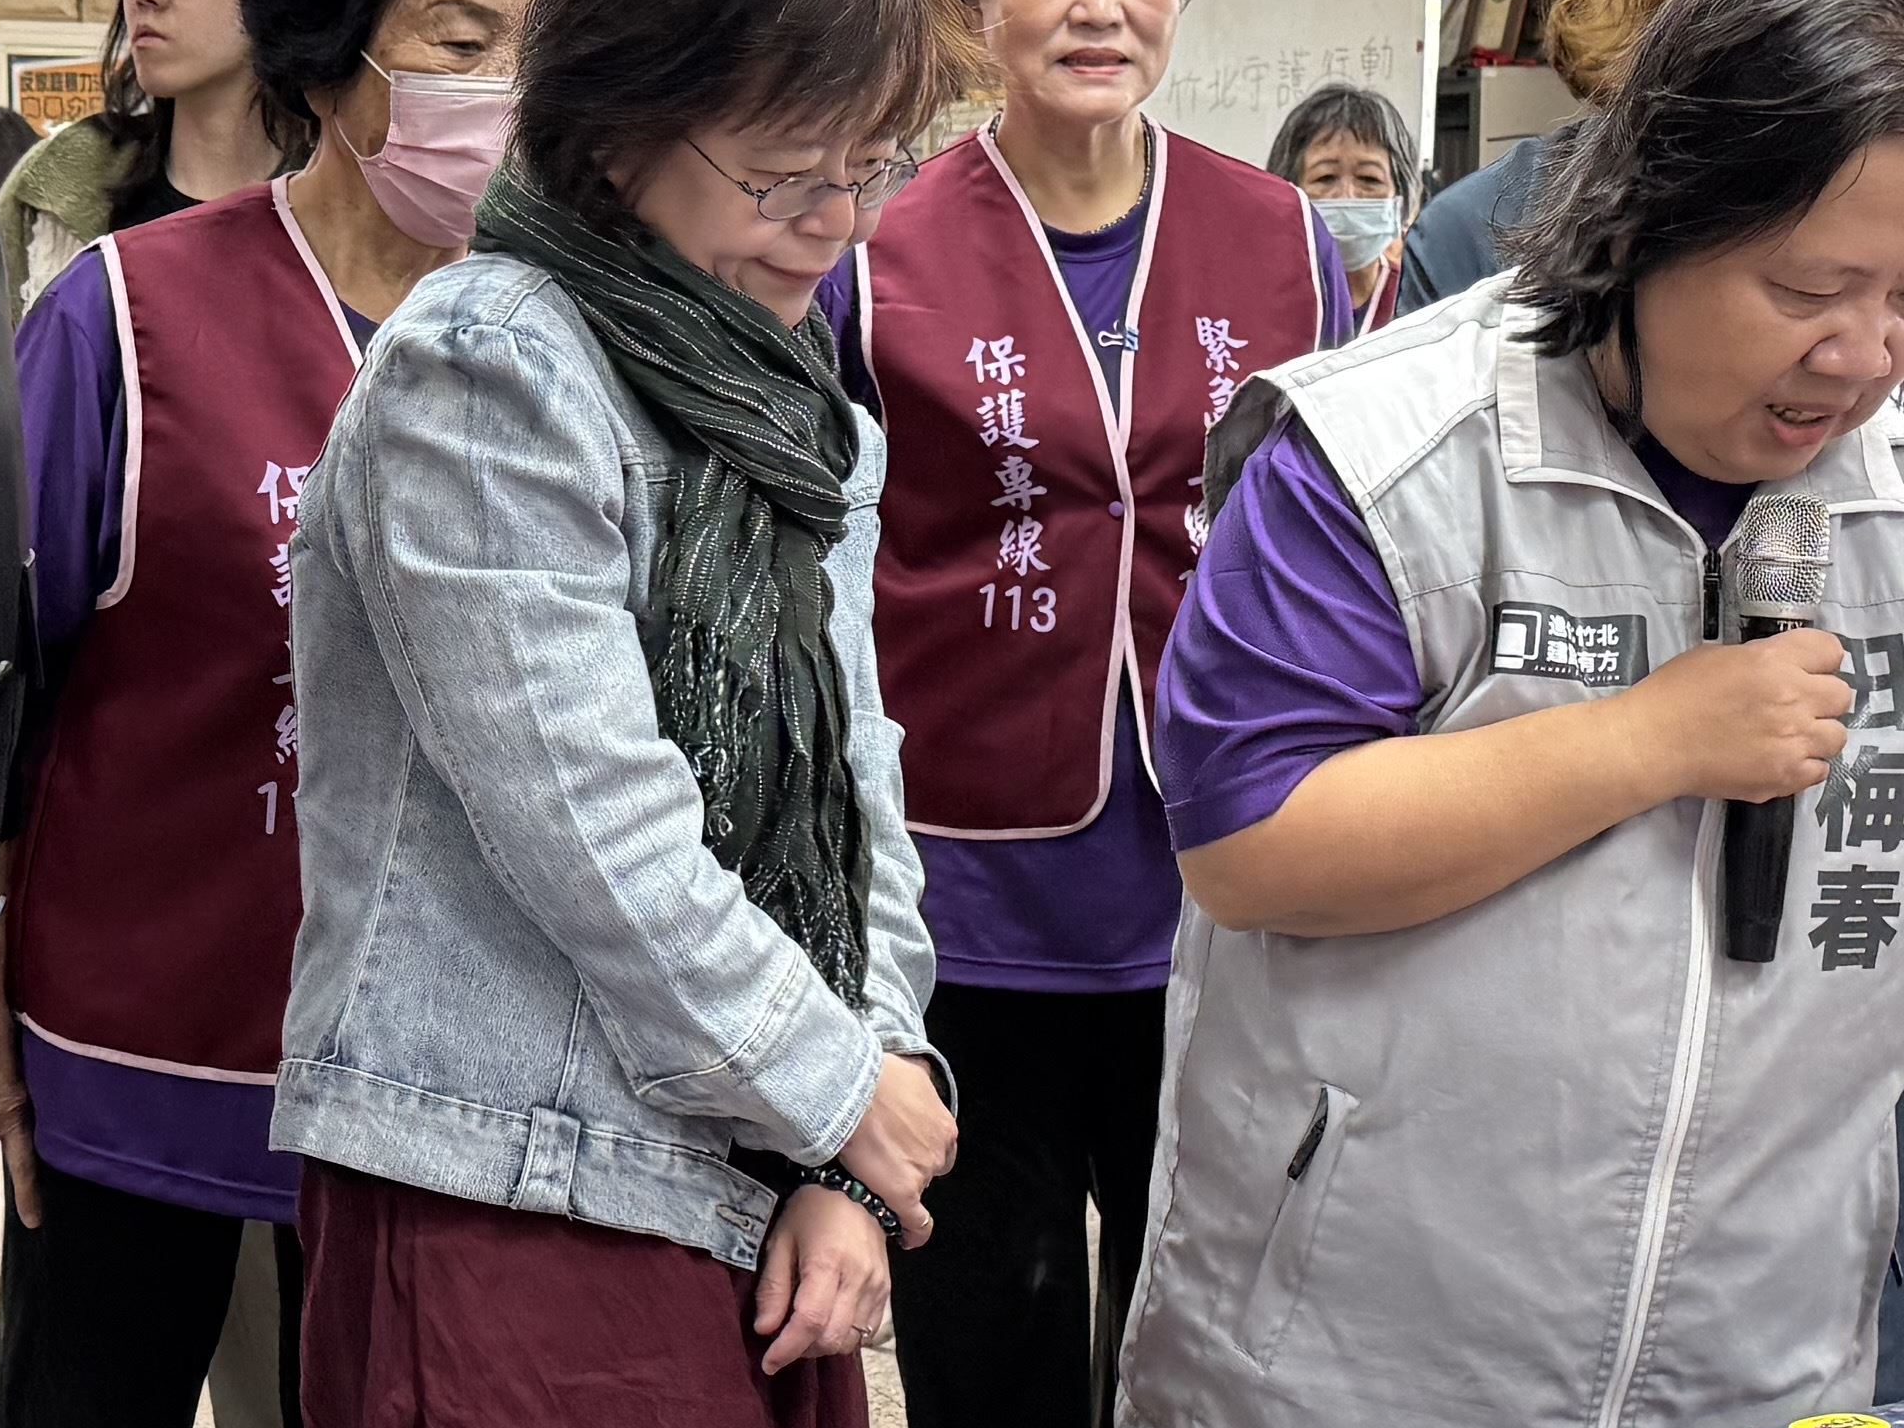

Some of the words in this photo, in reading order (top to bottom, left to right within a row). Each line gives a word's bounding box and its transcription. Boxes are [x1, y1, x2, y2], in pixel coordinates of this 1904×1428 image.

[965, 335, 1051, 577] 保護專線
[979, 583, 1057, 633] 113
